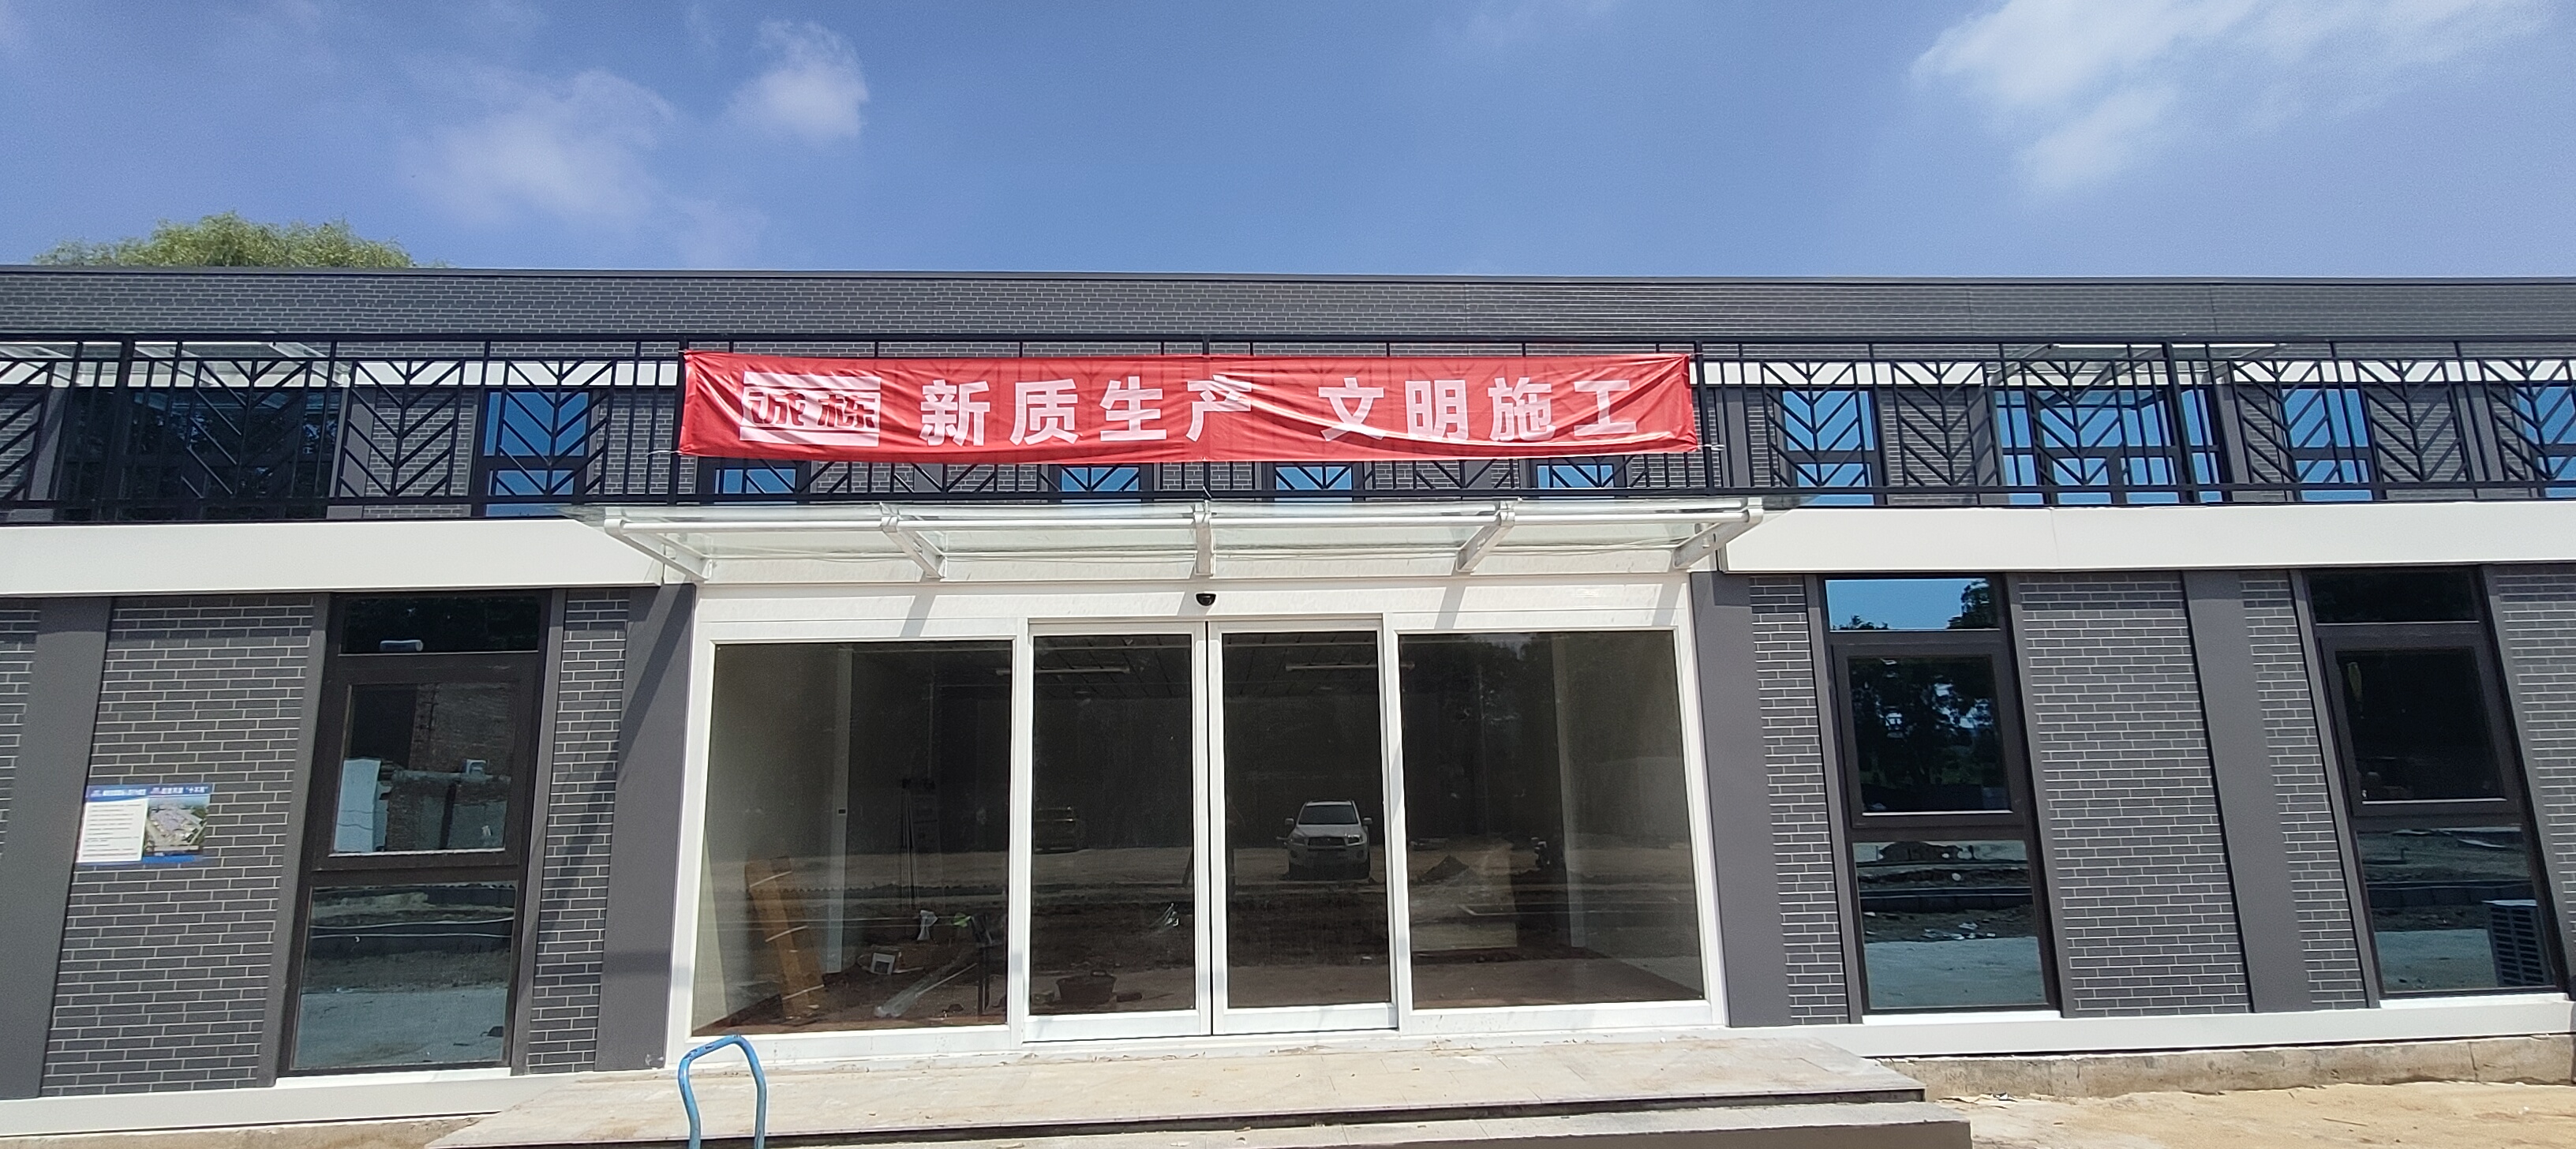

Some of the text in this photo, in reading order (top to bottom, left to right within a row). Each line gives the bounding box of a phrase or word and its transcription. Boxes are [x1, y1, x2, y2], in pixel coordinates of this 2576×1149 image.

[747, 391, 875, 428] 诚栋
[919, 375, 1638, 447] 新质生产 文明施工
